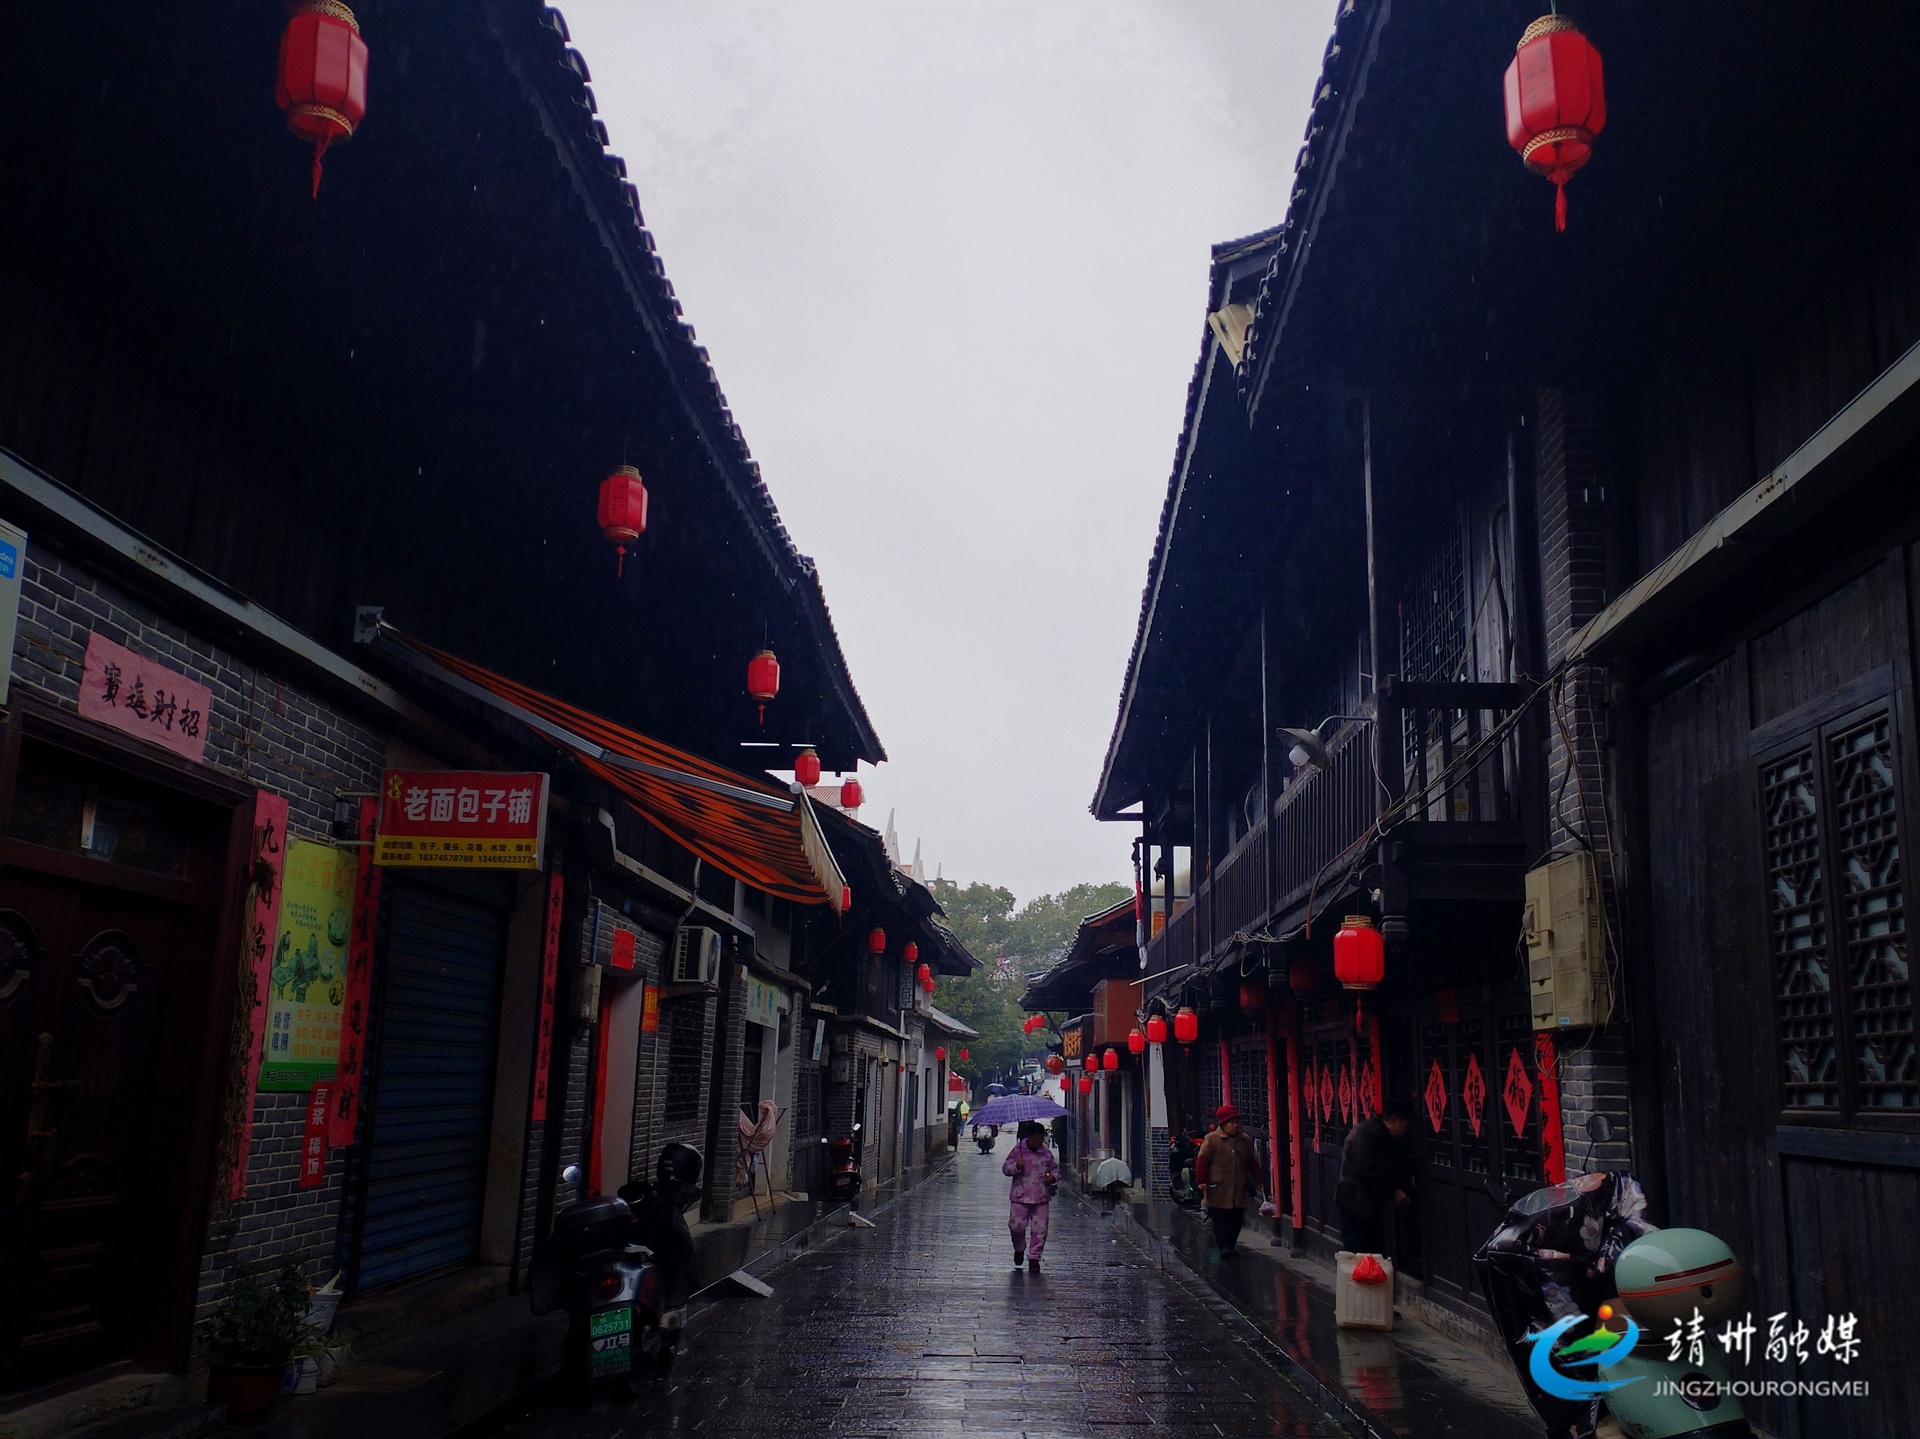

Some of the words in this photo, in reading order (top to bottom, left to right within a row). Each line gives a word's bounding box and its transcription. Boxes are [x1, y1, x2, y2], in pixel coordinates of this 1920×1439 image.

[403, 785, 533, 824] 老面包子铺
[312, 1088, 329, 1125] 豆浆
[1468, 1069, 1481, 1120] 福
[307, 1136, 321, 1175] 稀饭
[592, 1320, 630, 1336] 0625731
